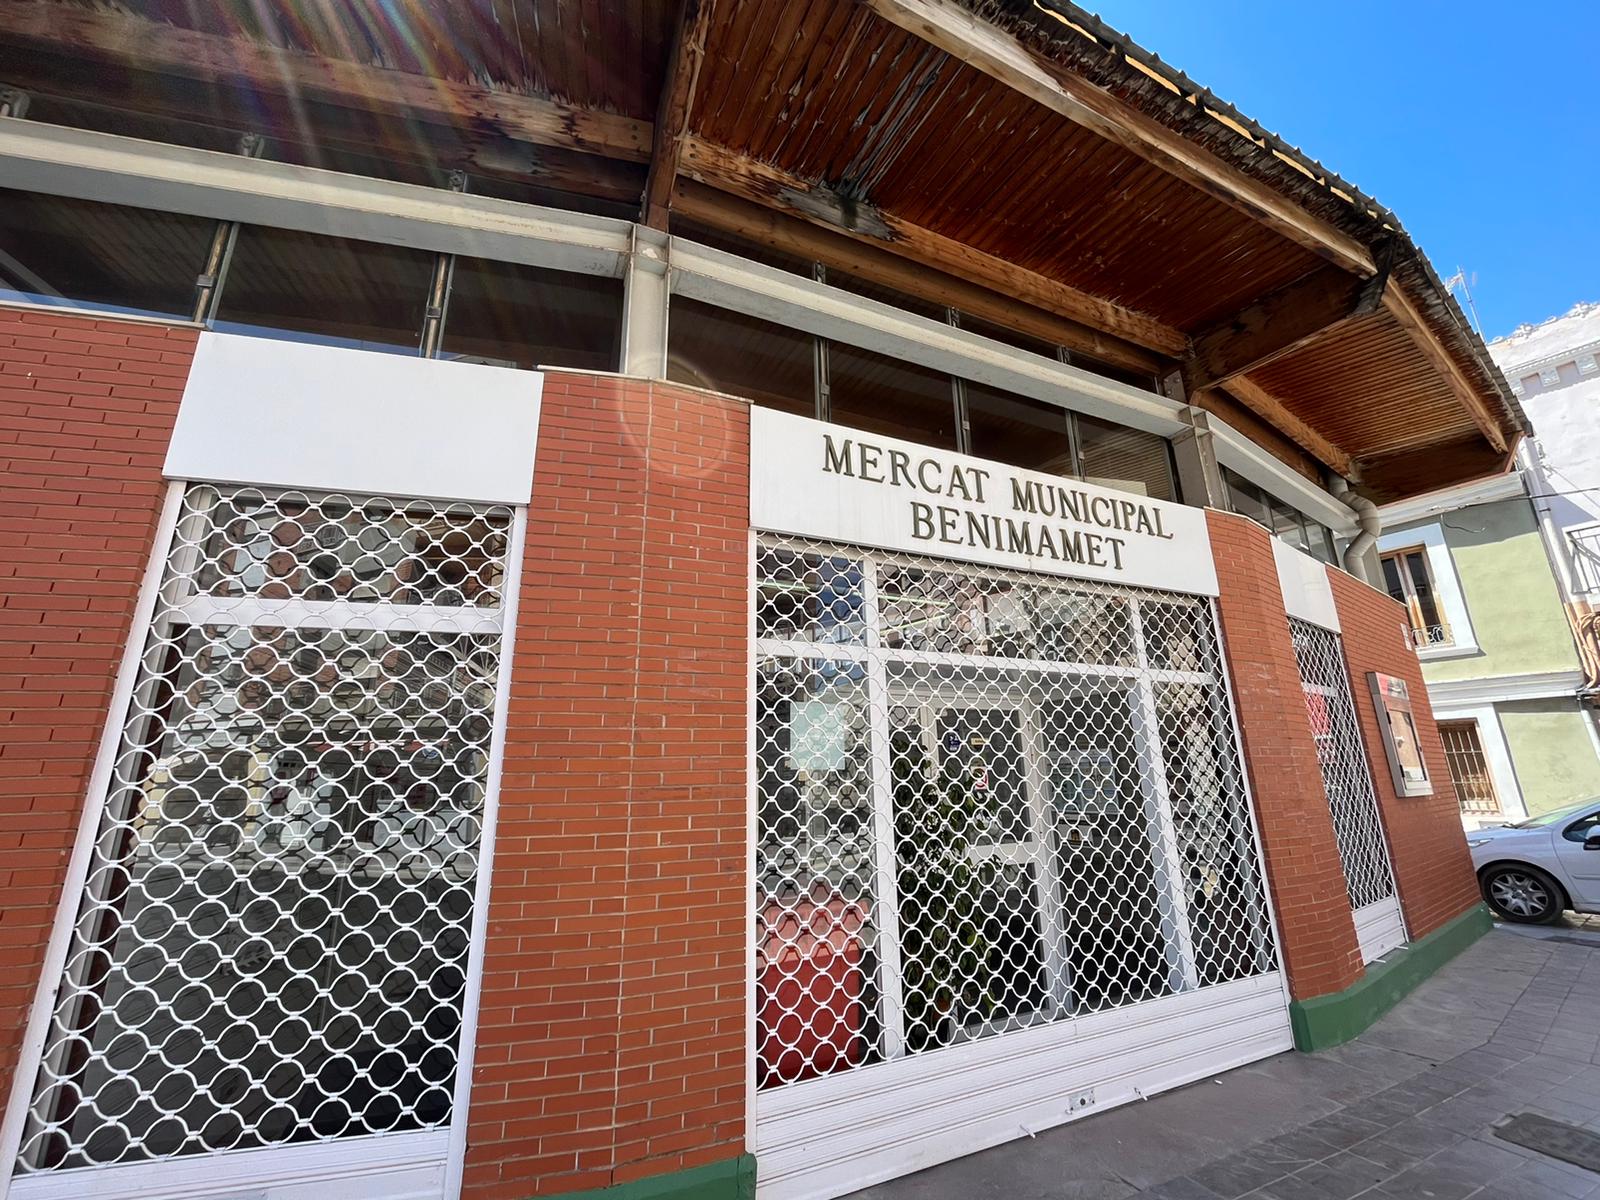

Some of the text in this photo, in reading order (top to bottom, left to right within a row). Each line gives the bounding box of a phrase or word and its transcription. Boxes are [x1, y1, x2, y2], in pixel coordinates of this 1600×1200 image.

[822, 435, 1174, 539] MERCAT MUNICIPAL
[910, 501, 1125, 570] BENIMAMET
